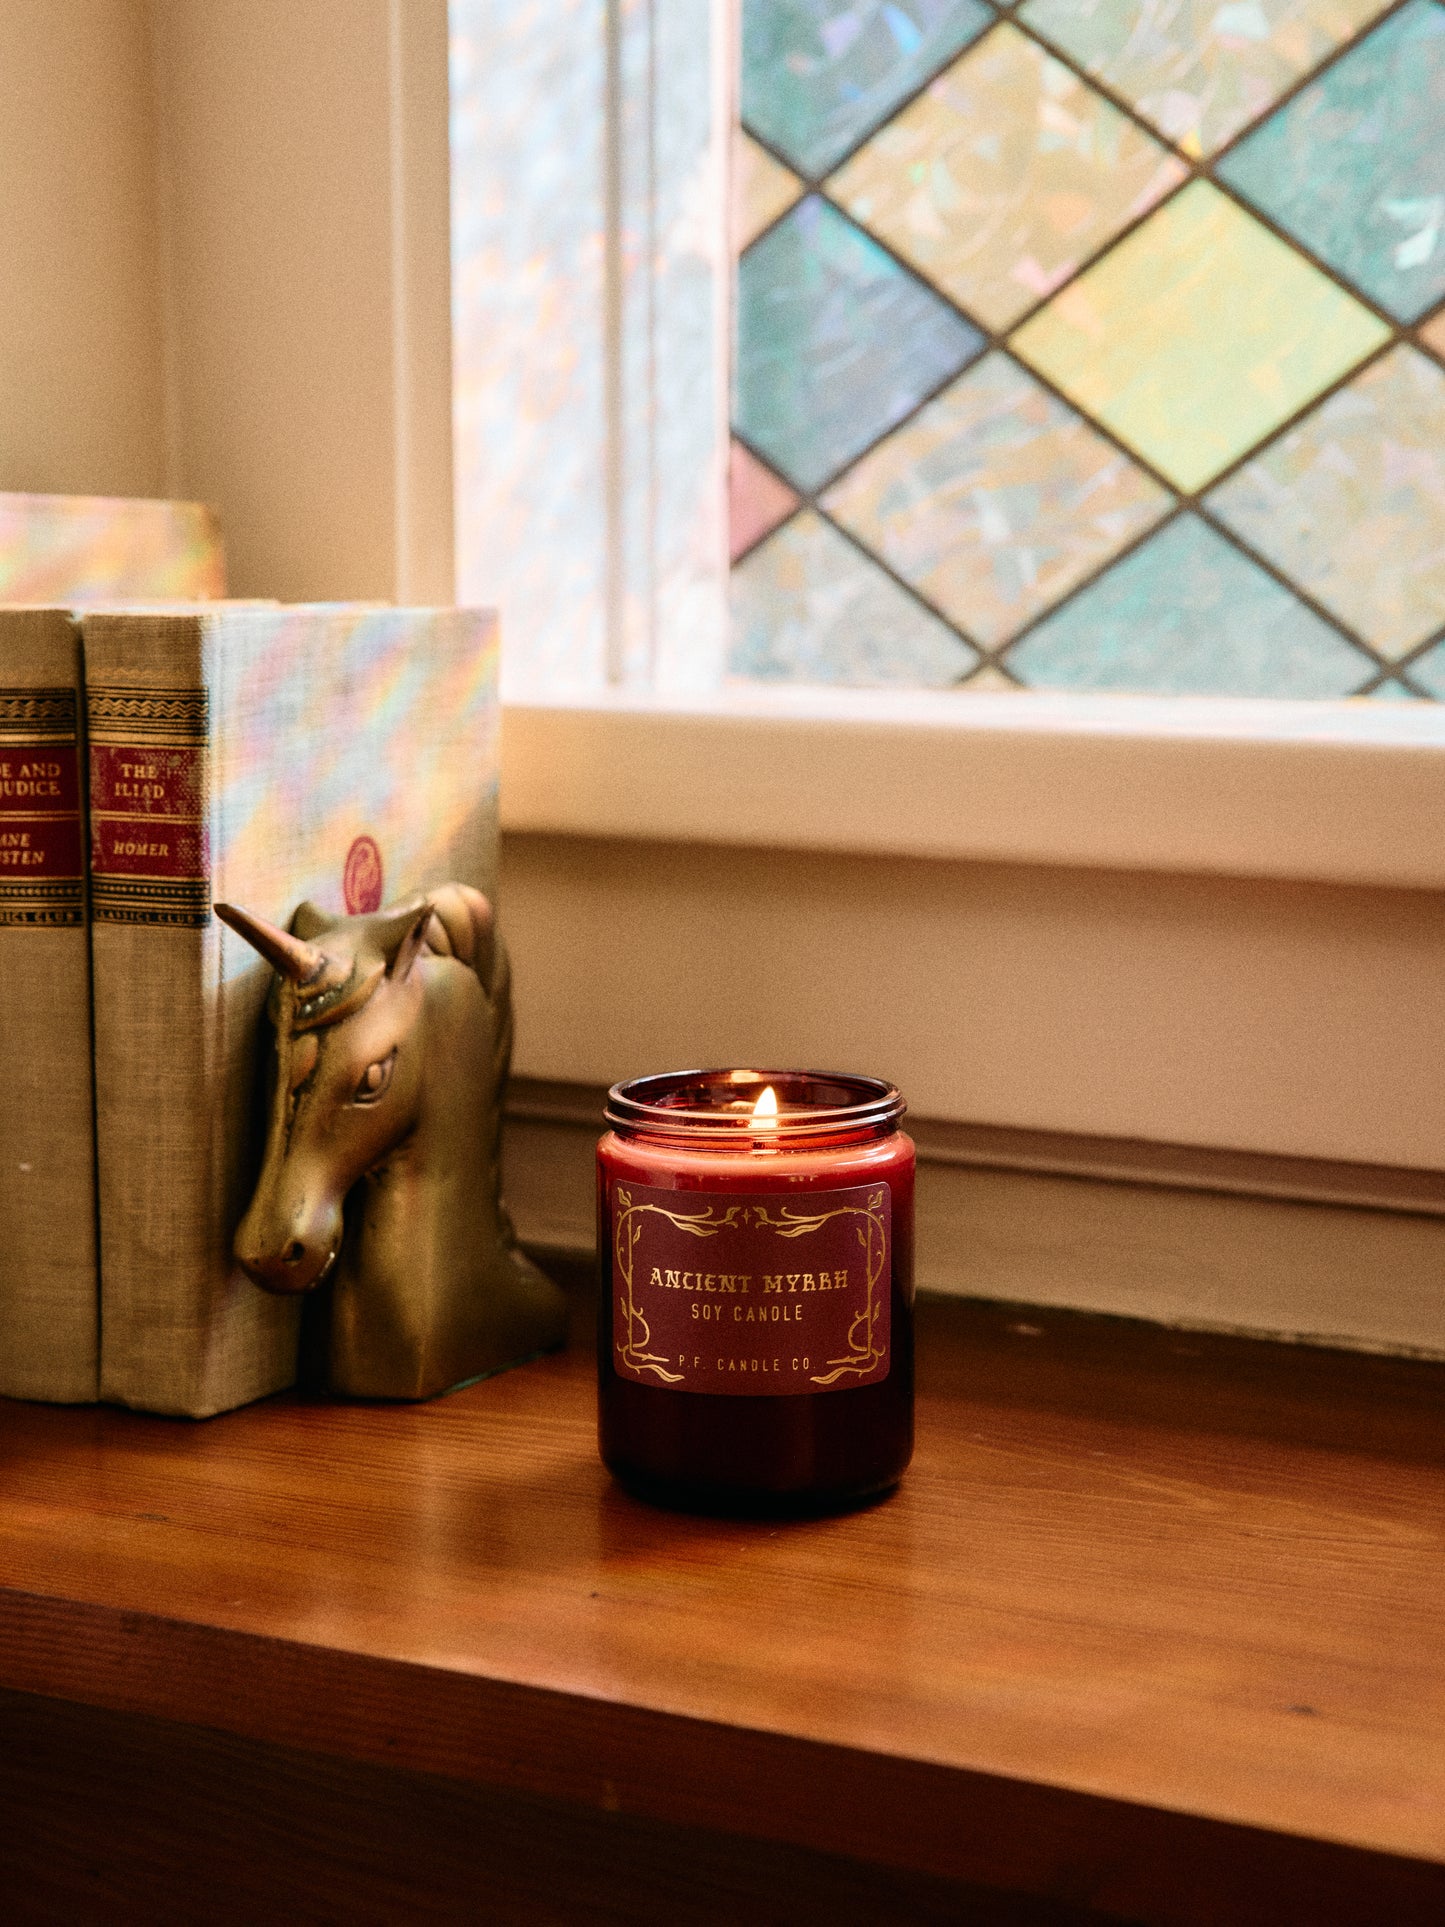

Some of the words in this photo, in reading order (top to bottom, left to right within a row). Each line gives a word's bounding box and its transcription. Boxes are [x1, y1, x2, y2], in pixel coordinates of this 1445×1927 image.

[19, 763, 61, 778] AND
[120, 764, 158, 779] THE
[114, 783, 164, 799] ILIAD
[113, 842, 169, 857] HOMER
[649, 1267, 751, 1294] ANCIENT
[762, 1269, 849, 1294] MYRRH
[691, 1303, 722, 1322] SOY
[734, 1304, 803, 1322] CANDLE
[679, 1355, 706, 1372] P.F.
[717, 1358, 780, 1372] CANDLE
[792, 1357, 816, 1370] CO.
